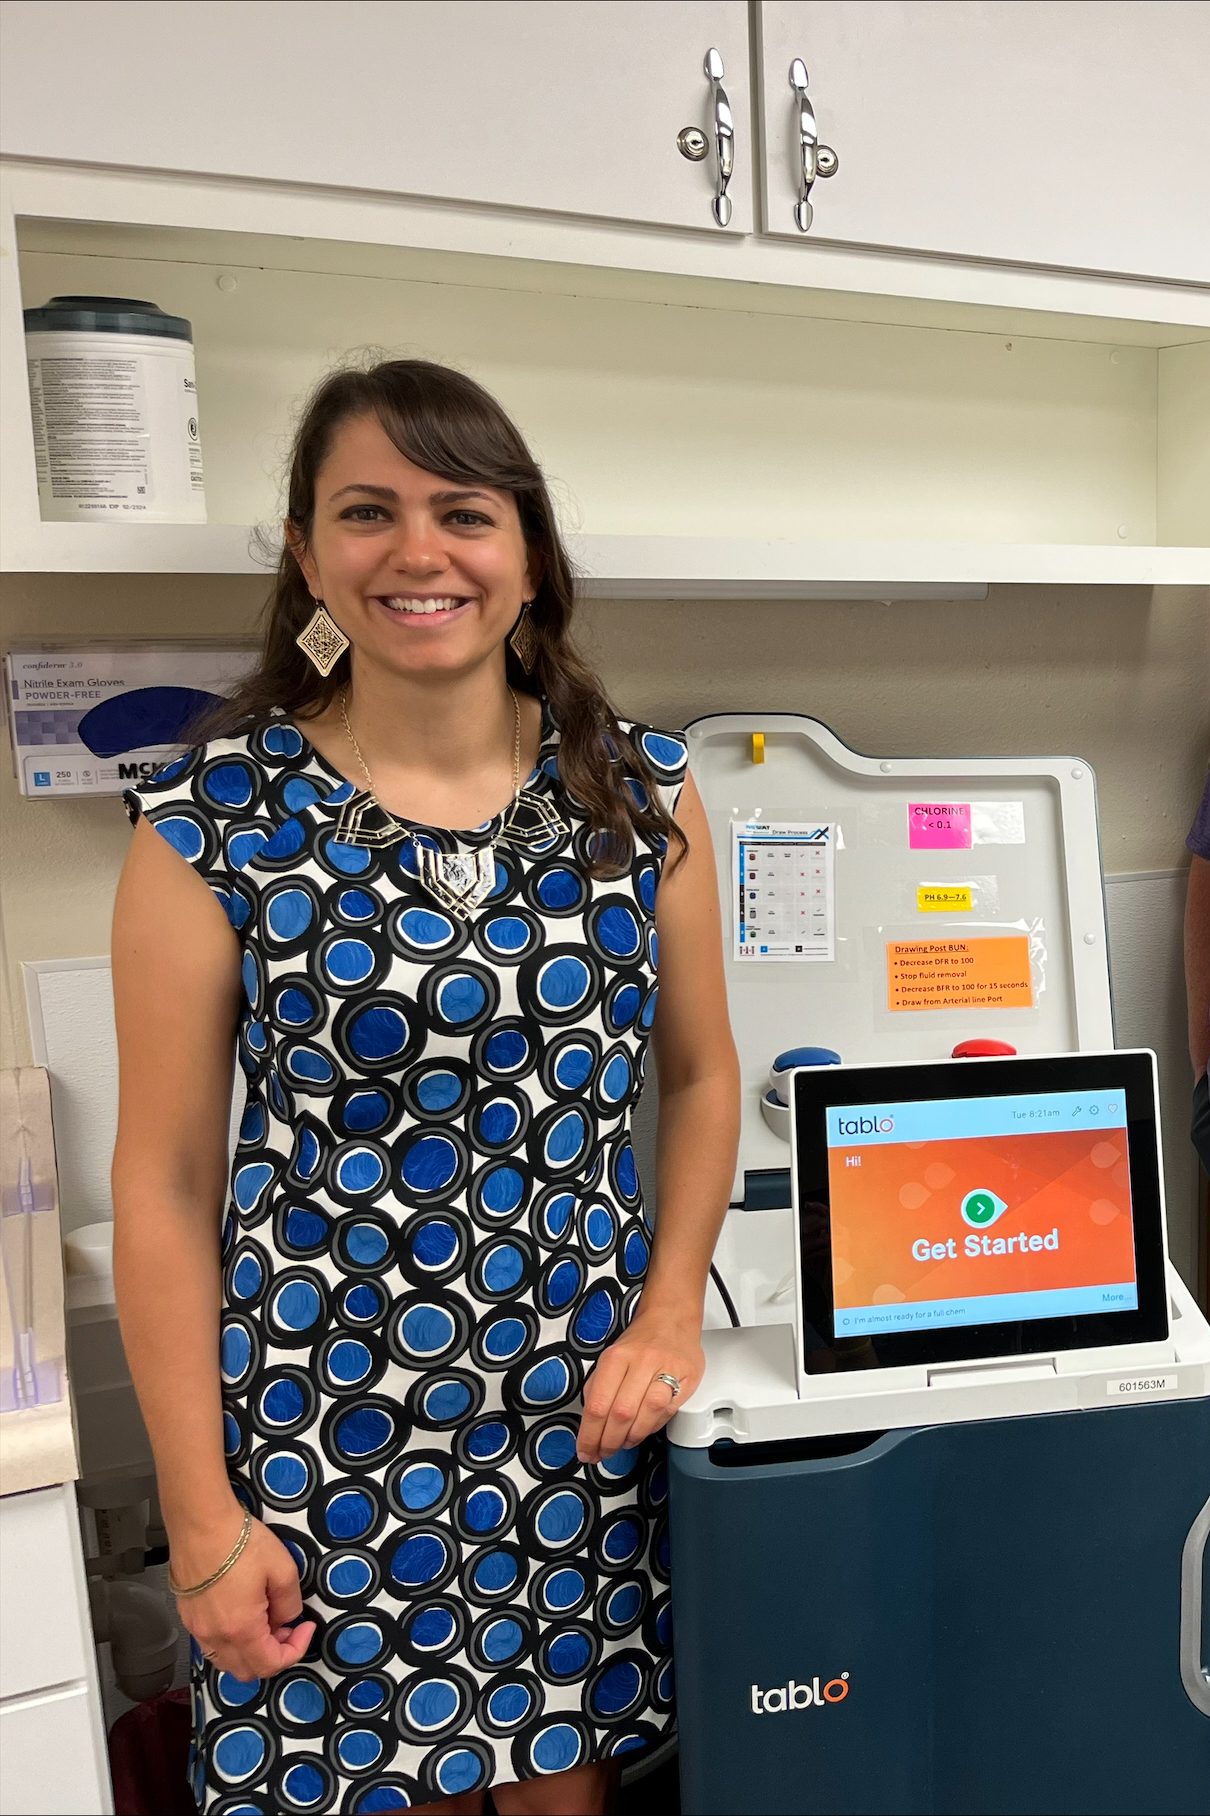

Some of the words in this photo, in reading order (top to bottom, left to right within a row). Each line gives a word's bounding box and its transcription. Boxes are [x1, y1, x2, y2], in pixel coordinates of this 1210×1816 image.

[69, 661, 83, 669] 3.0
[24, 680, 54, 689] Nitrile
[57, 679, 85, 688] Exam
[87, 678, 125, 687] Gloves
[25, 690, 102, 700] POWDER-FREE
[39, 773, 46, 781] L
[914, 807, 965, 816] CHLORINE
[936, 821, 952, 829] 0.1
[924, 893, 935, 901] PH
[929, 944, 947, 952] Post
[1000, 981, 1028, 989] seconds
[1012, 1111, 1027, 1119] Tue
[1029, 1109, 1060, 1118] 8:21am
[838, 1115, 894, 1135] tablo
[845, 1156, 862, 1167] Hi!
[912, 1238, 957, 1261] Get
[964, 1228, 1059, 1257] Started
[868, 1314, 892, 1323] almost
[894, 1313, 914, 1321] ready
[915, 1311, 926, 1319] for
[933, 1309, 945, 1317] full
[945, 1308, 966, 1316] chem
[1118, 1379, 1166, 1392] 601563M
[751, 1676, 849, 1714] tablo
